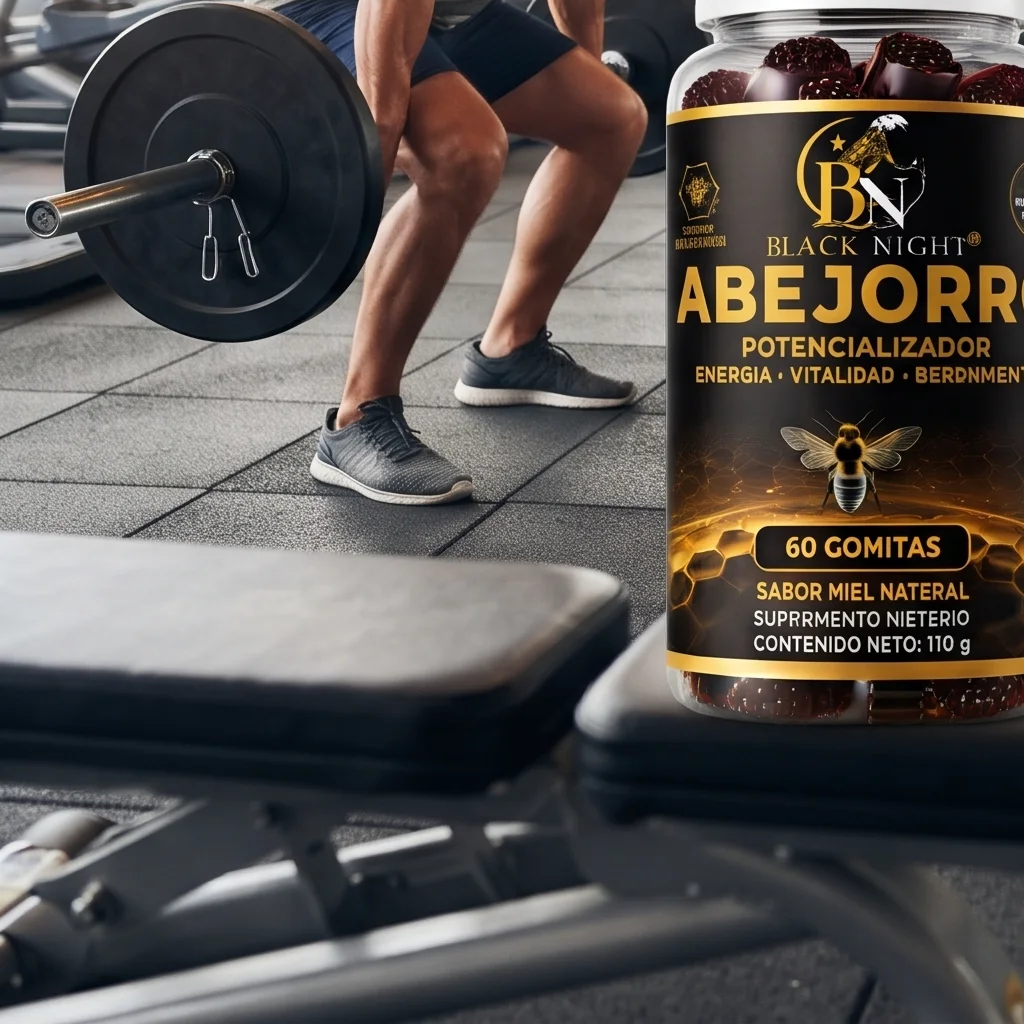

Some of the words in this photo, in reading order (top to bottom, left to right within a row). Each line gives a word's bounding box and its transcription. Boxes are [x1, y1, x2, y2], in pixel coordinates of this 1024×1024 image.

[767, 236, 857, 256] BLACK
[742, 336, 990, 358] POTENCIALIZADOR
[696, 366, 772, 383] ENERGIA
[790, 367, 894, 383] VITALIDAD
[786, 537, 816, 558] 60
[825, 536, 940, 558] GOMITAS
[757, 582, 822, 601] SABOR
[829, 583, 874, 600] MIEL
[881, 582, 969, 600] NATERAL
[754, 610, 880, 627] SUPRRMENTO
[887, 610, 969, 627] NIETERIO
[754, 635, 861, 652] CONTENIDO
[868, 636, 921, 653] NETO:
[928, 635, 953, 652] 110
[960, 639, 970, 655] g
